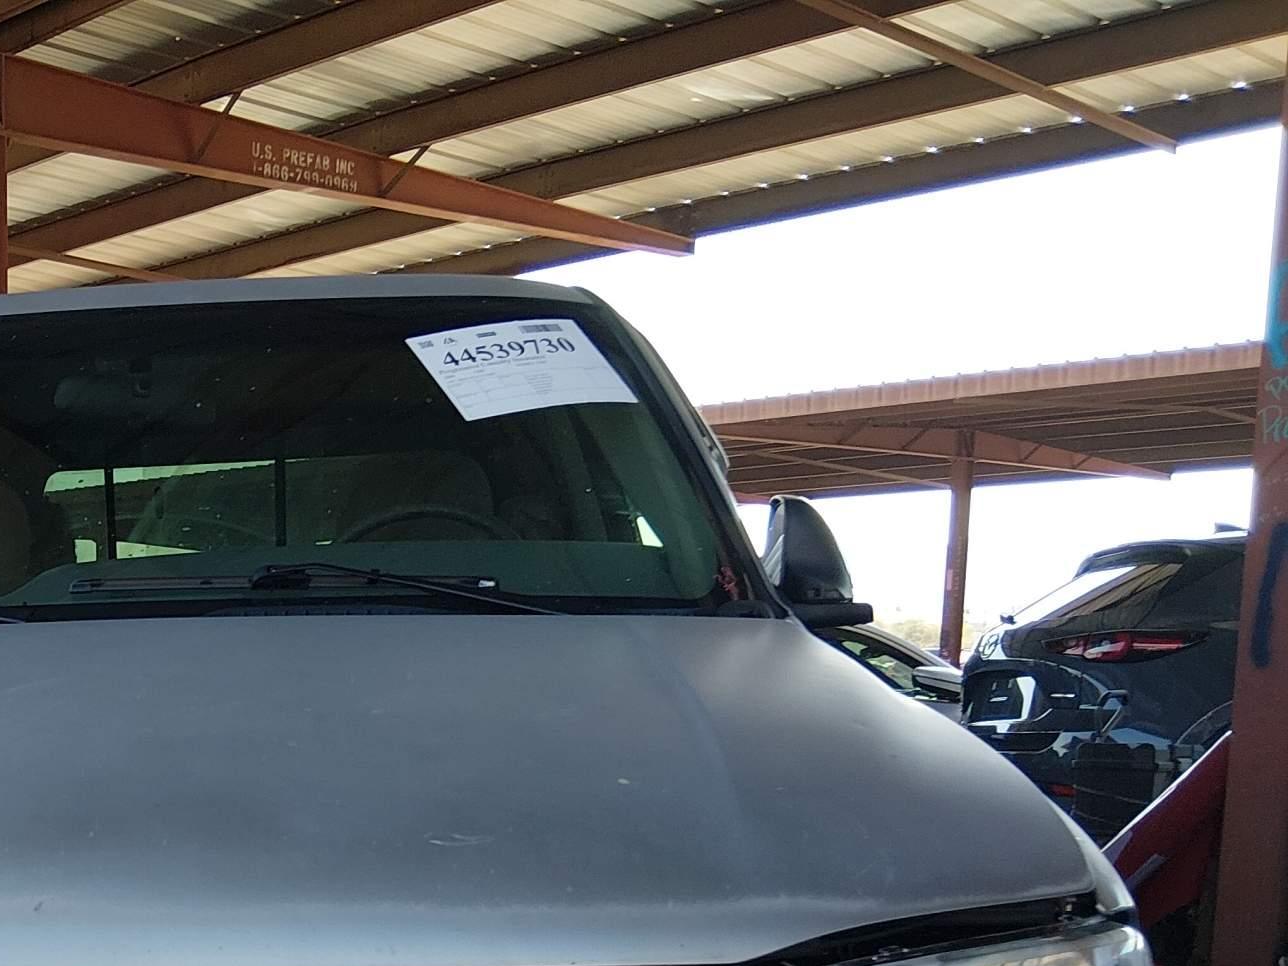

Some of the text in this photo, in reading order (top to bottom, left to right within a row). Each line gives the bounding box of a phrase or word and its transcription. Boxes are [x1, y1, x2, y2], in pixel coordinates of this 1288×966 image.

[251, 141, 355, 176] U.S. PREFAB INC
[442, 336, 576, 367] 44539730
